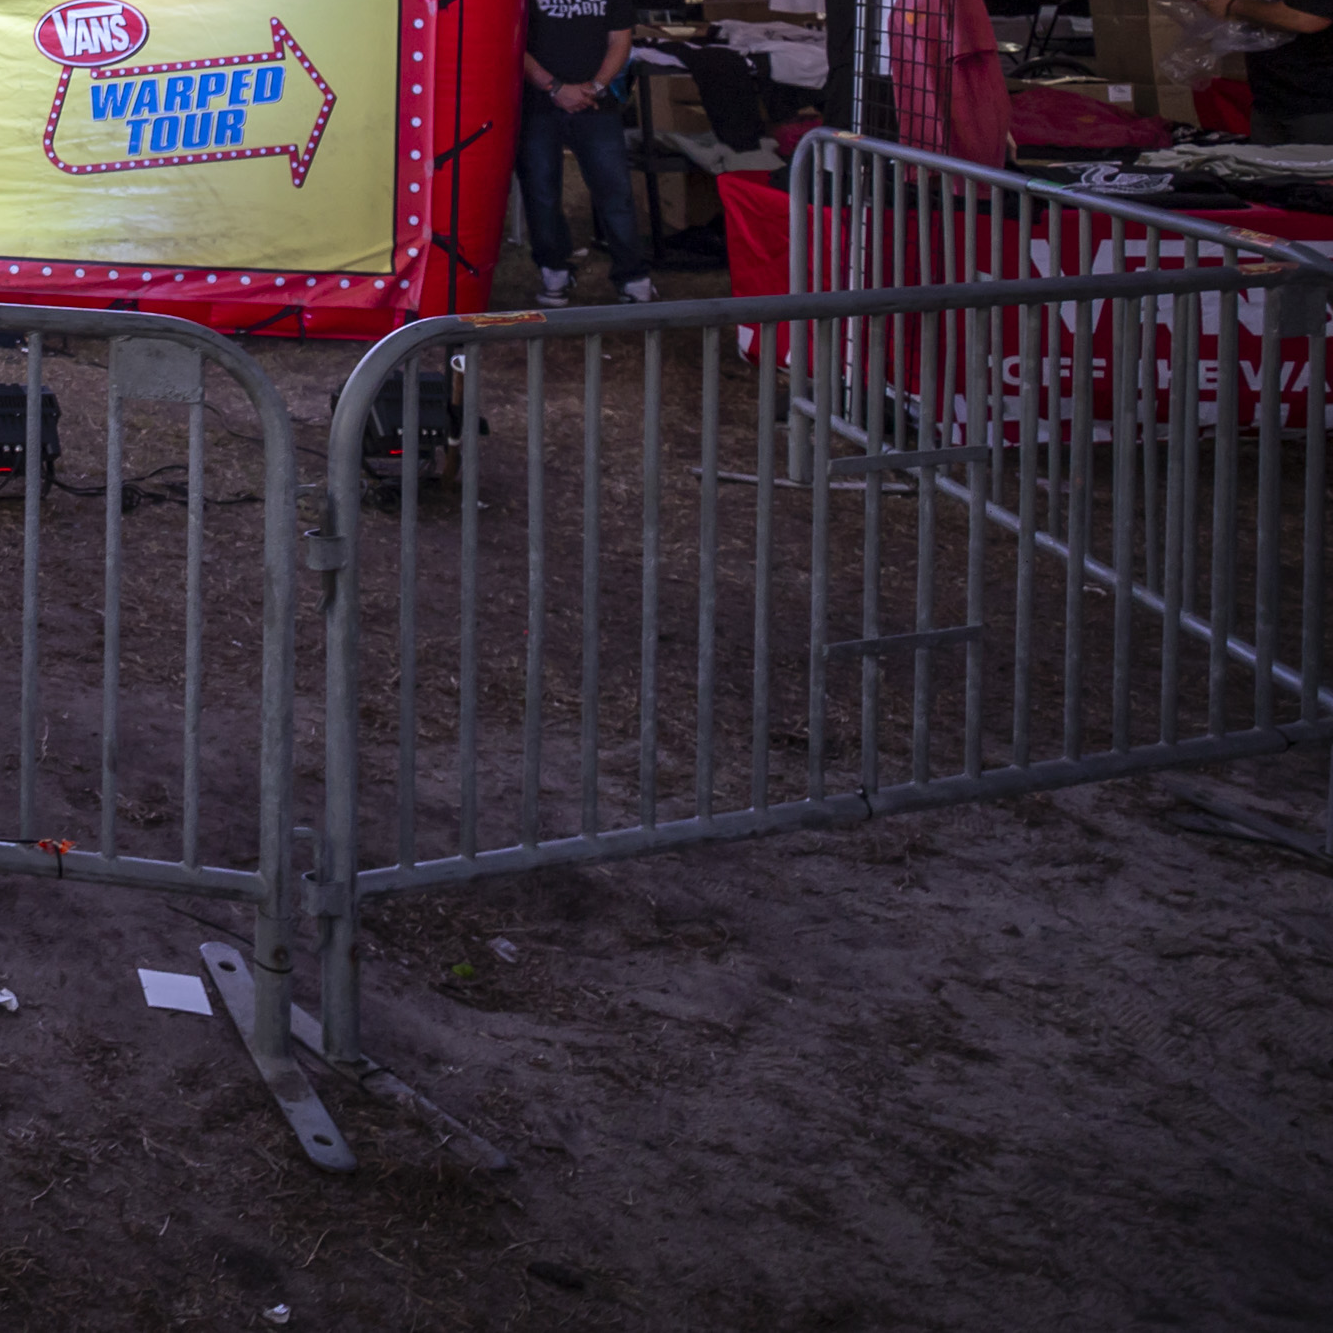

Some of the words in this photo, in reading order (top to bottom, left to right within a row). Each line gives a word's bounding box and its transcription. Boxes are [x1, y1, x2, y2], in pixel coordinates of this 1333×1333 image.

[52, 3, 131, 55] VANS
[547, 1, 607, 17] ZOMBIE
[89, 65, 286, 121] WARPED
[127, 108, 248, 155] TOUR
